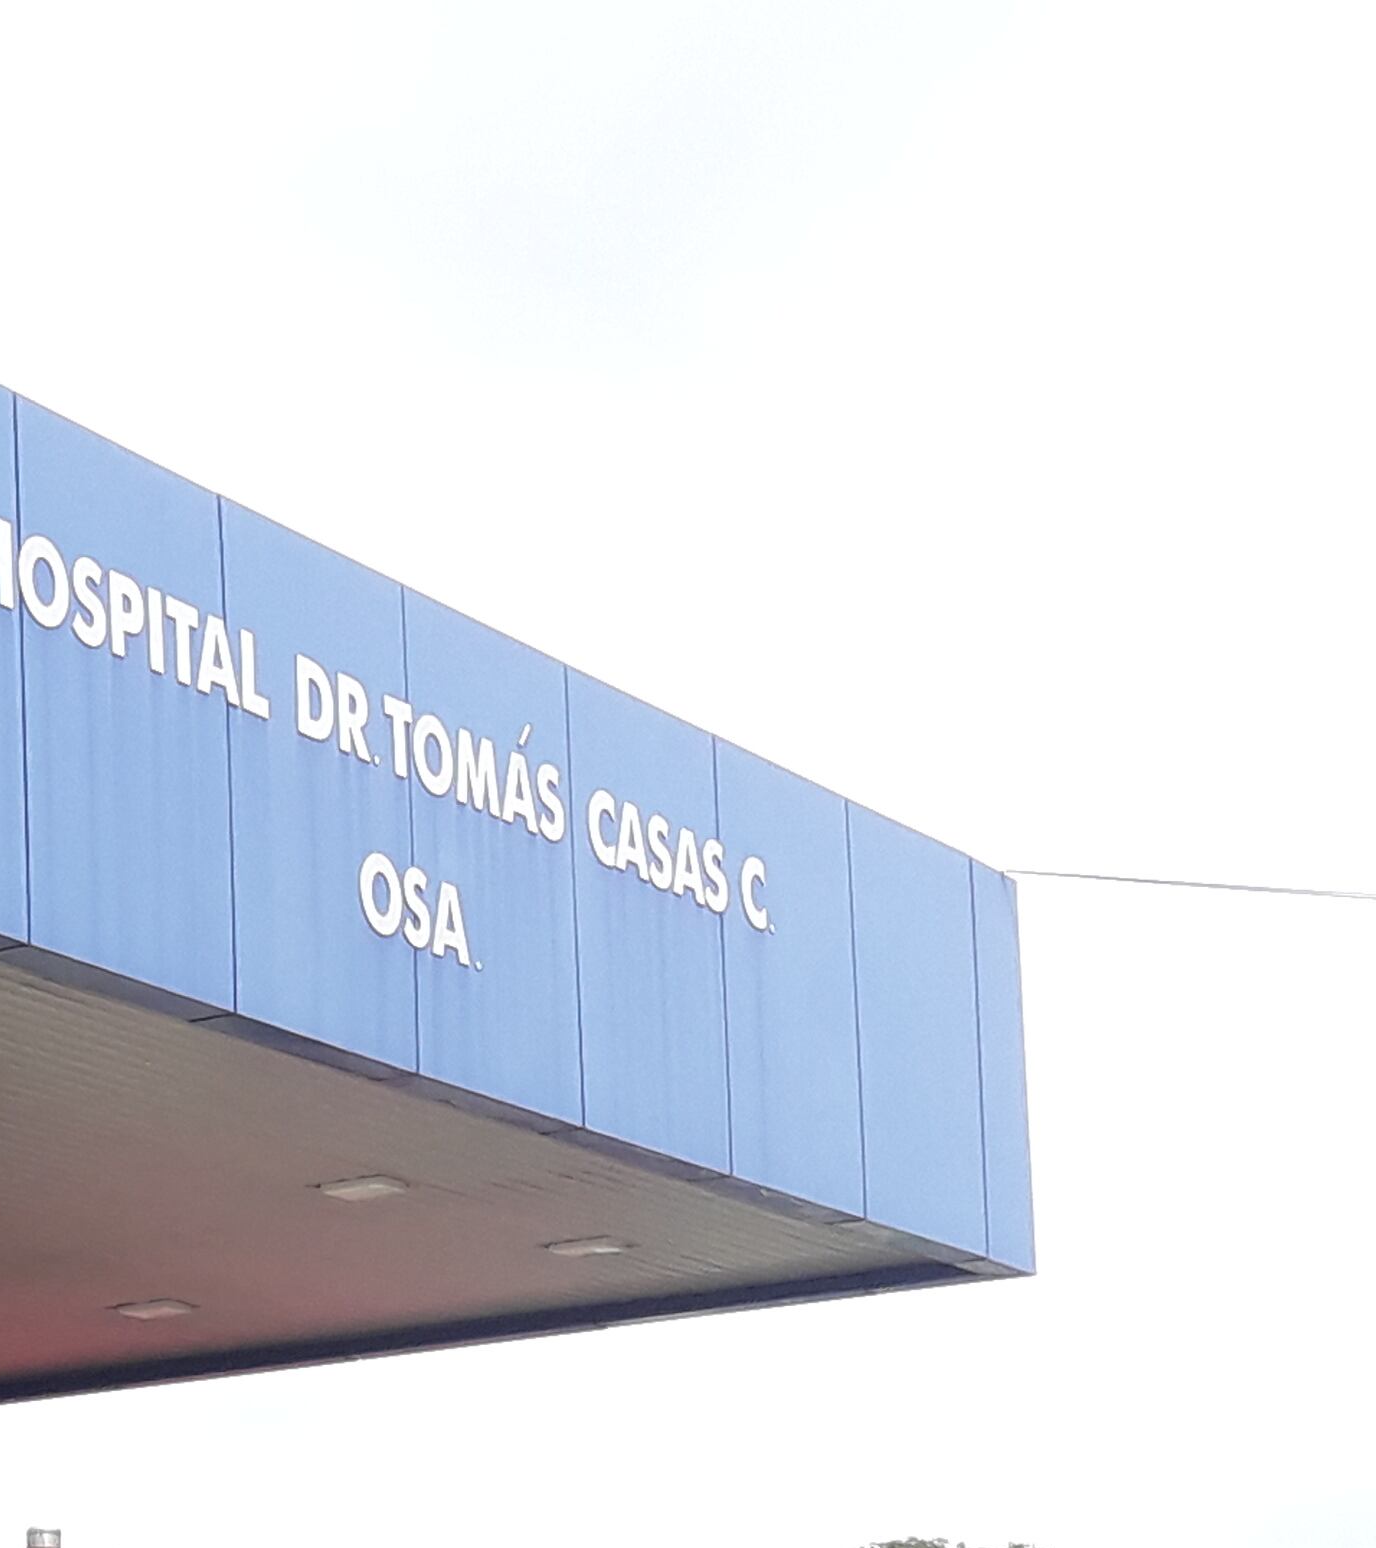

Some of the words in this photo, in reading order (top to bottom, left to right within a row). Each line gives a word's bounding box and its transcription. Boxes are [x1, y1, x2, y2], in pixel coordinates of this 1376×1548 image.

[294, 652, 381, 768] DR.
[382, 694, 566, 842] TOMÁS
[586, 788, 729, 914] CASAS
[740, 855, 776, 935] C.
[358, 851, 483, 971] OSA.
